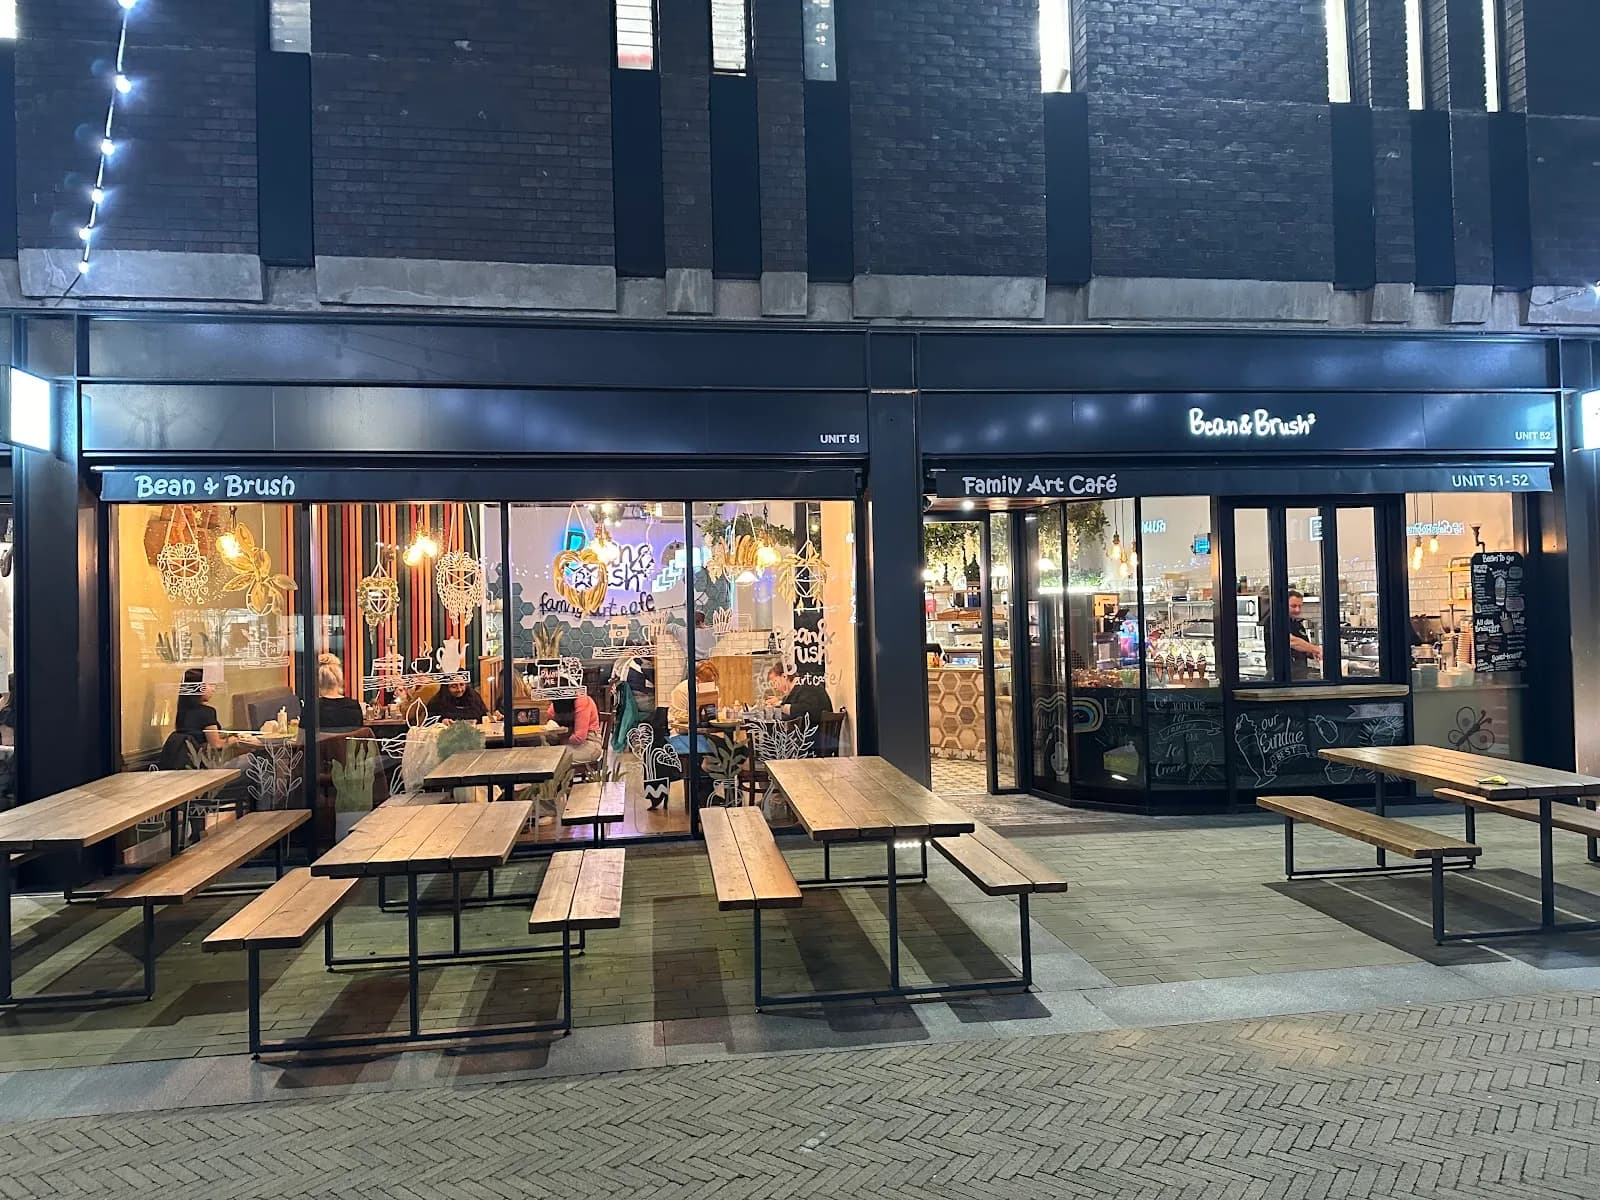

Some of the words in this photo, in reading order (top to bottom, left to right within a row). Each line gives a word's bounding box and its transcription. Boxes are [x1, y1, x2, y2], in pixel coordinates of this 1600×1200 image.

[819, 434, 848, 444] UNIT
[849, 434, 860, 443] 51
[1515, 431, 1539, 441] UNIT
[1540, 431, 1552, 440] 52
[134, 474, 196, 498] Bean
[203, 476, 220, 495] &
[223, 474, 296, 497] Brush
[962, 474, 1023, 495] Family
[1026, 476, 1064, 495] Art
[1069, 473, 1119, 495] Café
[1451, 474, 1486, 488] UNIT
[1261, 714, 1279, 731] our
[1277, 746, 1297, 761] BEST
